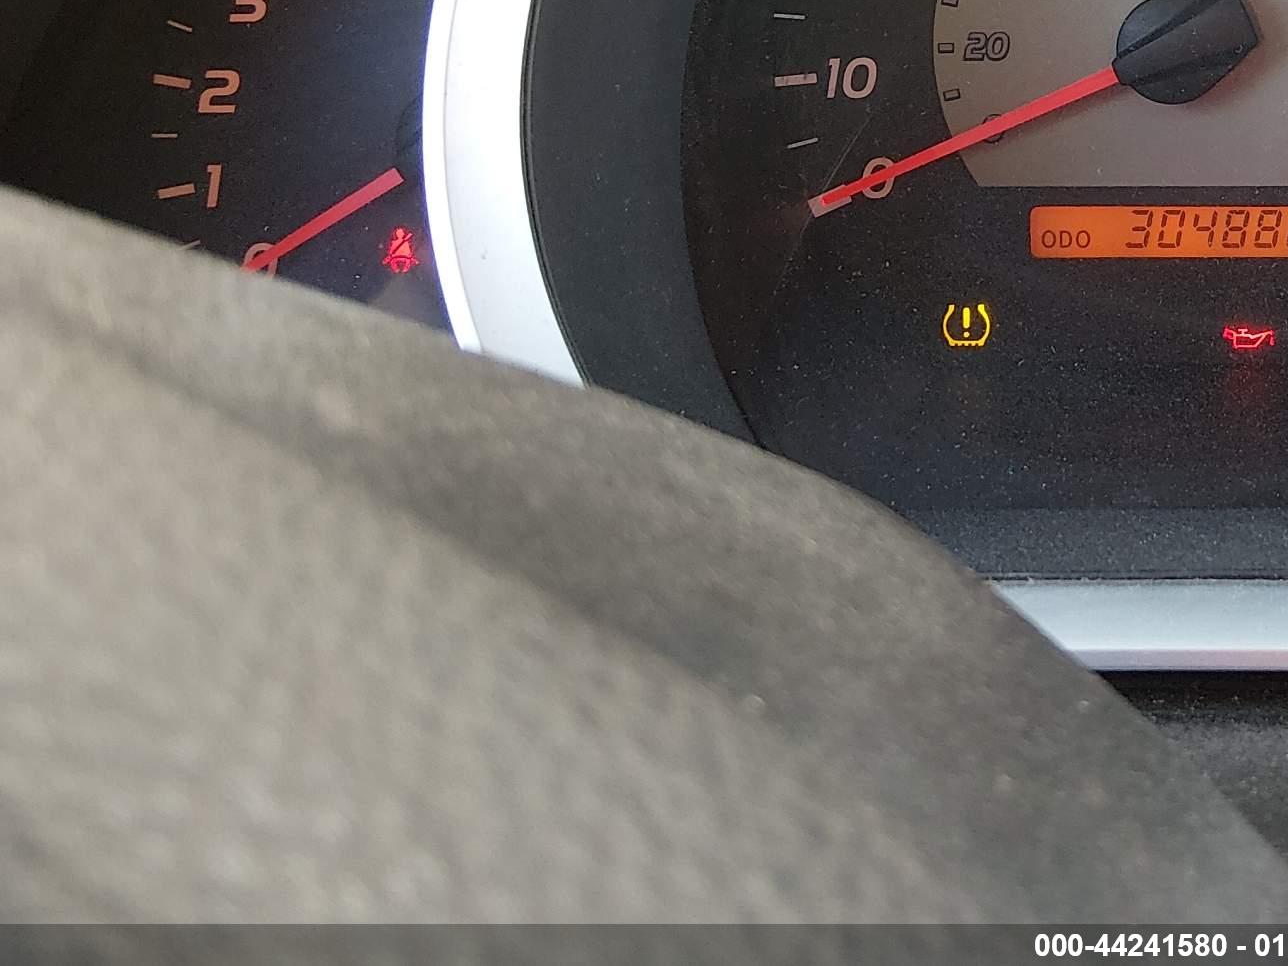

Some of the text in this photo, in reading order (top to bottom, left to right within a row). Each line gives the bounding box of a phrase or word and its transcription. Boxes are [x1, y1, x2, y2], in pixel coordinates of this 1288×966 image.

[963, 32, 1011, 62] 20
[198, 69, 242, 114] 2
[825, 56, 879, 99] 10
[206, 164, 222, 208] 1
[862, 156, 896, 199] 0
[1041, 229, 1091, 249] ODO
